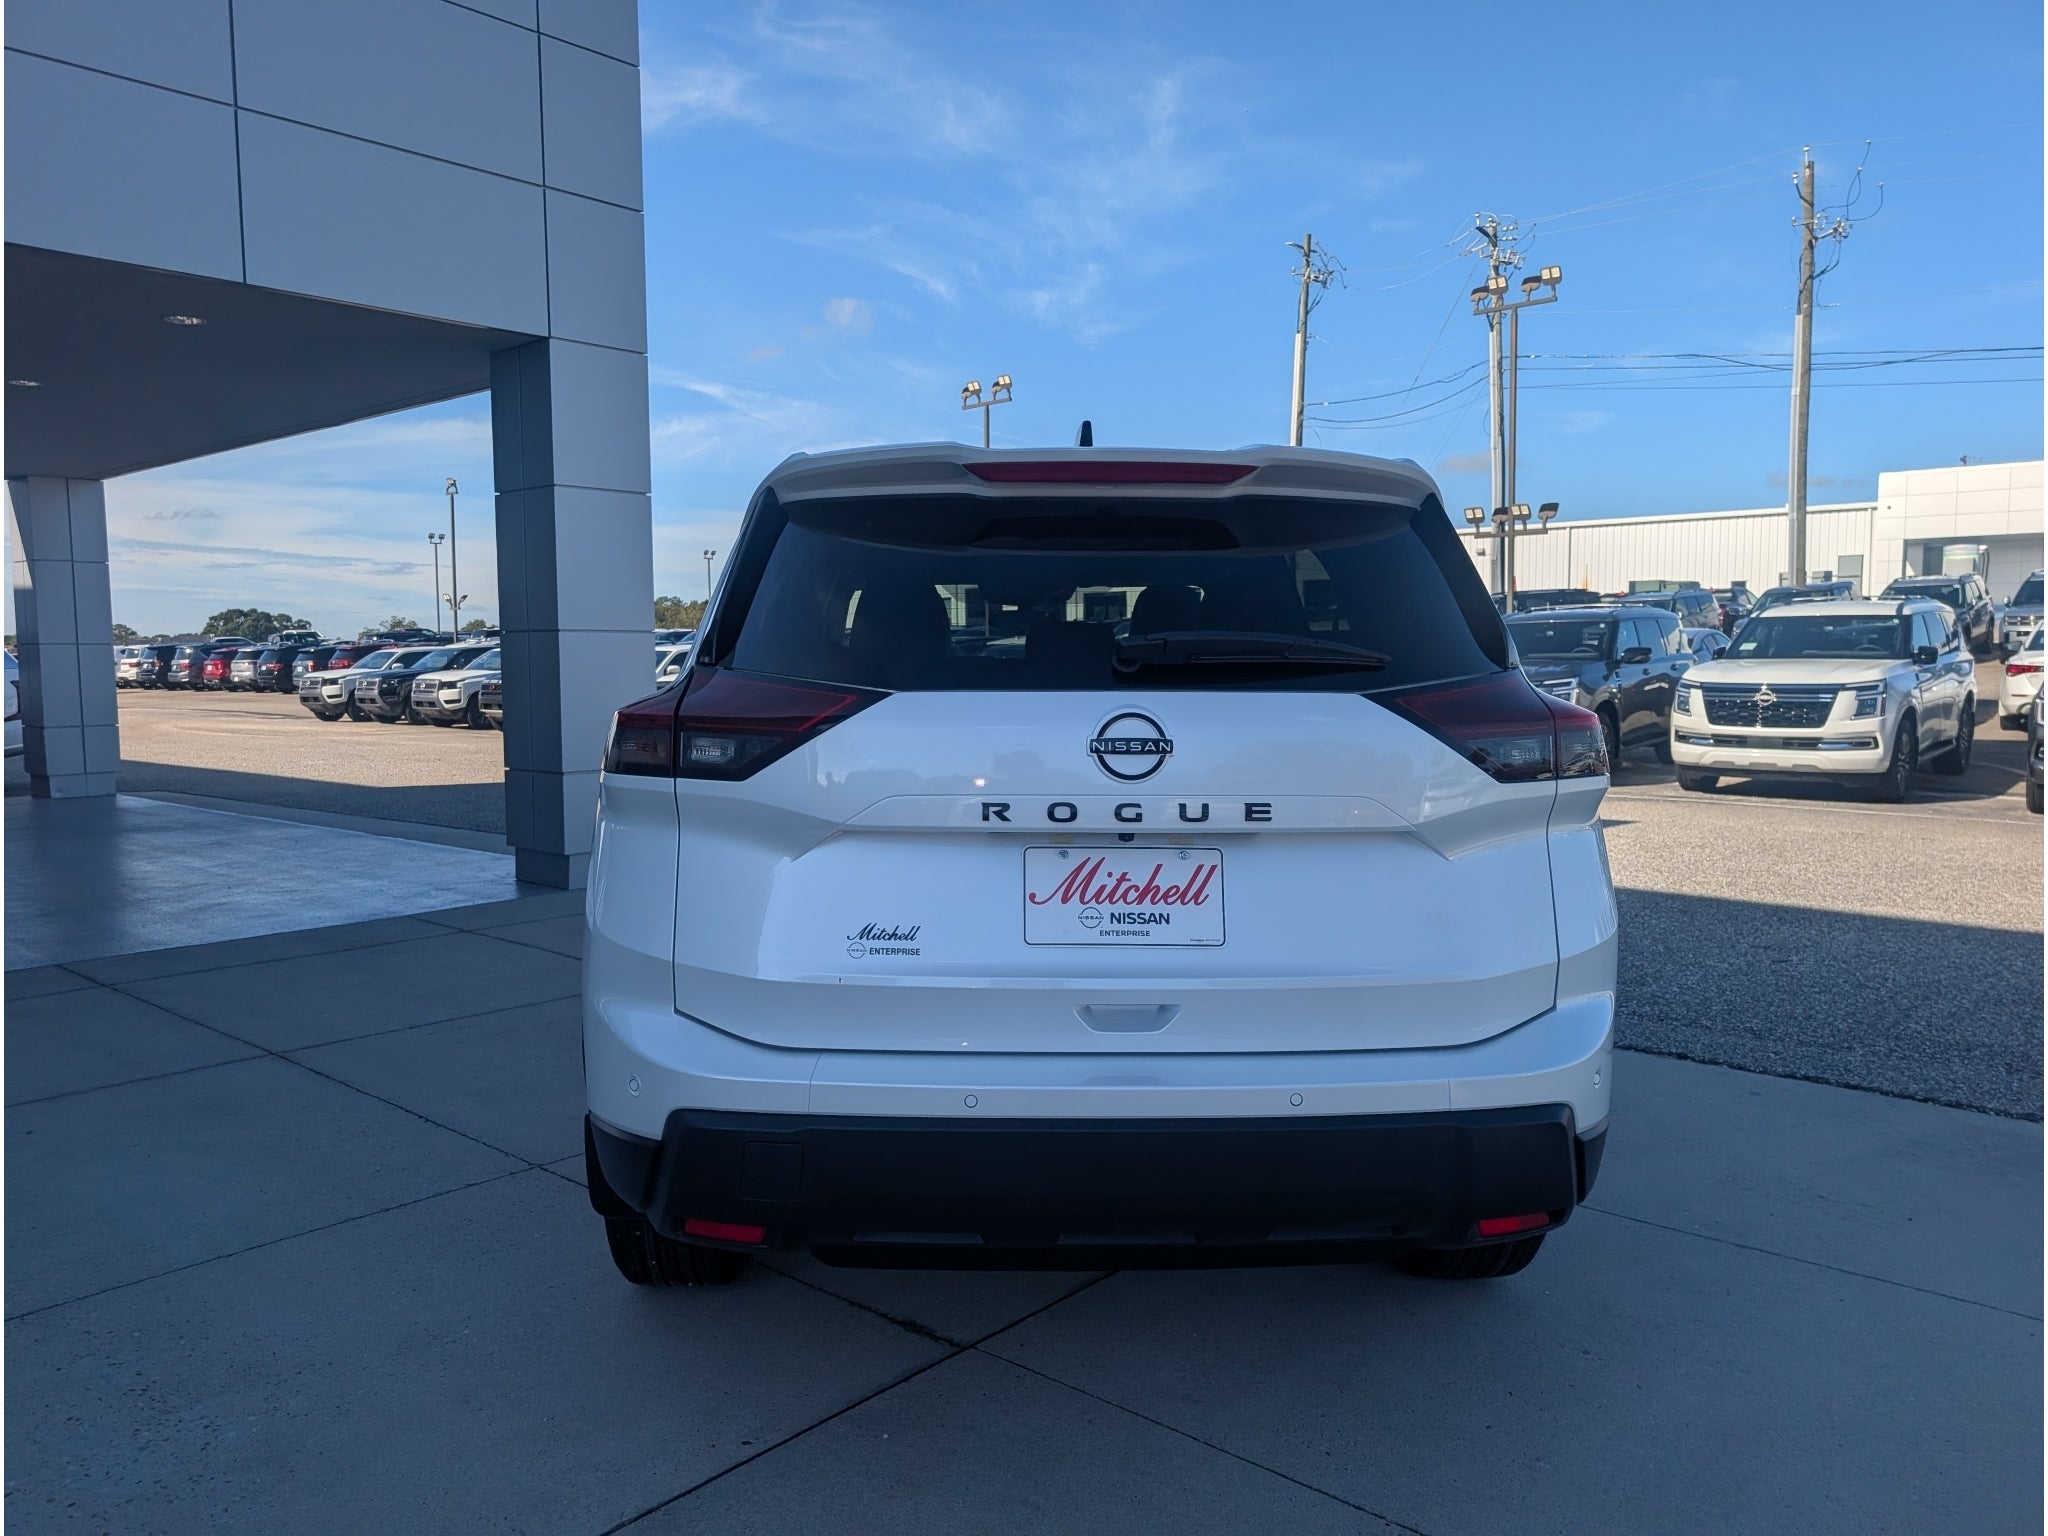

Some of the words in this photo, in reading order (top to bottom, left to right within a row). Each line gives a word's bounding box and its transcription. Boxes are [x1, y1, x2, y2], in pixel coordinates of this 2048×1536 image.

[1091, 740, 1172, 752] NISSAN
[981, 801, 1273, 823] ROGUE
[1028, 856, 1218, 906] Mitchell
[1110, 912, 1170, 925] NISSAN
[847, 922, 921, 942] Mitchell
[1099, 929, 1151, 937] ENTERPRISE
[869, 947, 921, 956] ENTERPRISE
